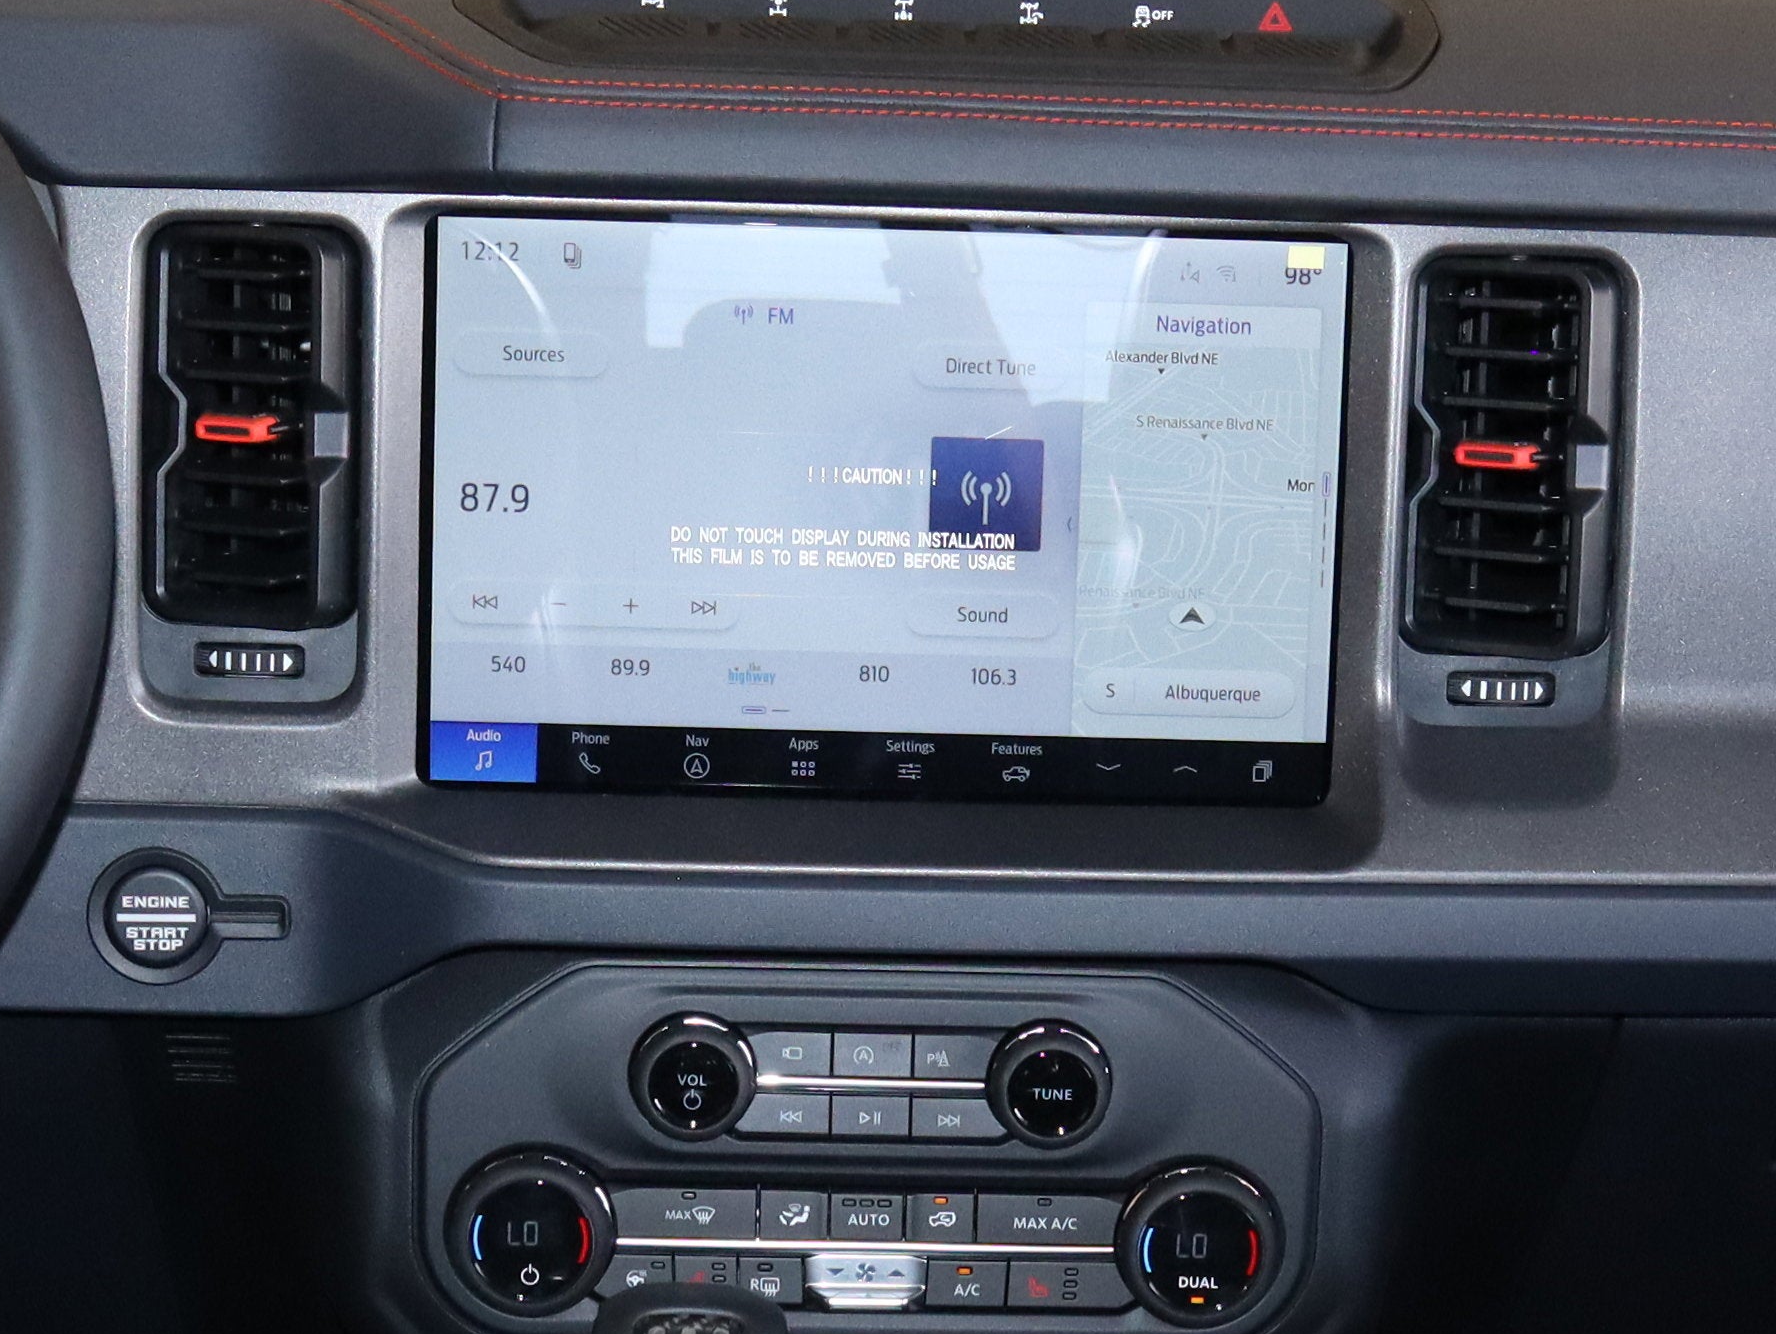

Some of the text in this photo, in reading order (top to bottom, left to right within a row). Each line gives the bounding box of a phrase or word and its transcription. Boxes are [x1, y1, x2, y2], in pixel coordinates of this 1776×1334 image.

[1152, 10, 1174, 20] OFF
[461, 240, 520, 263] 12:12
[768, 307, 795, 325] FM
[1156, 314, 1252, 337] Navigation
[502, 345, 565, 363] Sources
[1105, 350, 1219, 365] Alexander Blvd NE
[945, 357, 1036, 377] Direct Tune
[1136, 415, 1274, 432] S Renaissance Blvd NE
[460, 482, 530, 513] 87.9
[671, 526, 1015, 550] DO NOT TOUCH DISPLAY DURING INSTALLATION
[671, 547, 1016, 571] THIS FILM IS TO BE REMOVED BEFORE USAGE
[957, 605, 1009, 624] Sound
[491, 655, 526, 673] 540
[611, 658, 651, 676] 89.9
[728, 667, 776, 685] highway
[859, 665, 890, 683] 810
[971, 667, 1017, 686] 106.3
[1106, 683, 1261, 704] S Albuquerque
[466, 728, 502, 743] Audio
[571, 730, 610, 746] Phone
[685, 734, 710, 747] Nav
[789, 737, 819, 752] Apps
[885, 739, 936, 755] Settings
[991, 741, 1043, 756] Features
[121, 895, 191, 909] ENGINE
[125, 926, 189, 939] START
[133, 939, 183, 951] STOP
[677, 1074, 707, 1088] VOL
[1032, 1087, 1073, 1101] TUNE
[664, 1208, 692, 1220] MAX
[848, 1213, 890, 1227] AUTO
[1013, 1217, 1078, 1231] MAX A/C
[507, 1221, 538, 1246] LO
[1176, 1233, 1207, 1259] LO
[953, 1283, 981, 1297] A/C
[1178, 1276, 1219, 1290] DUAL
